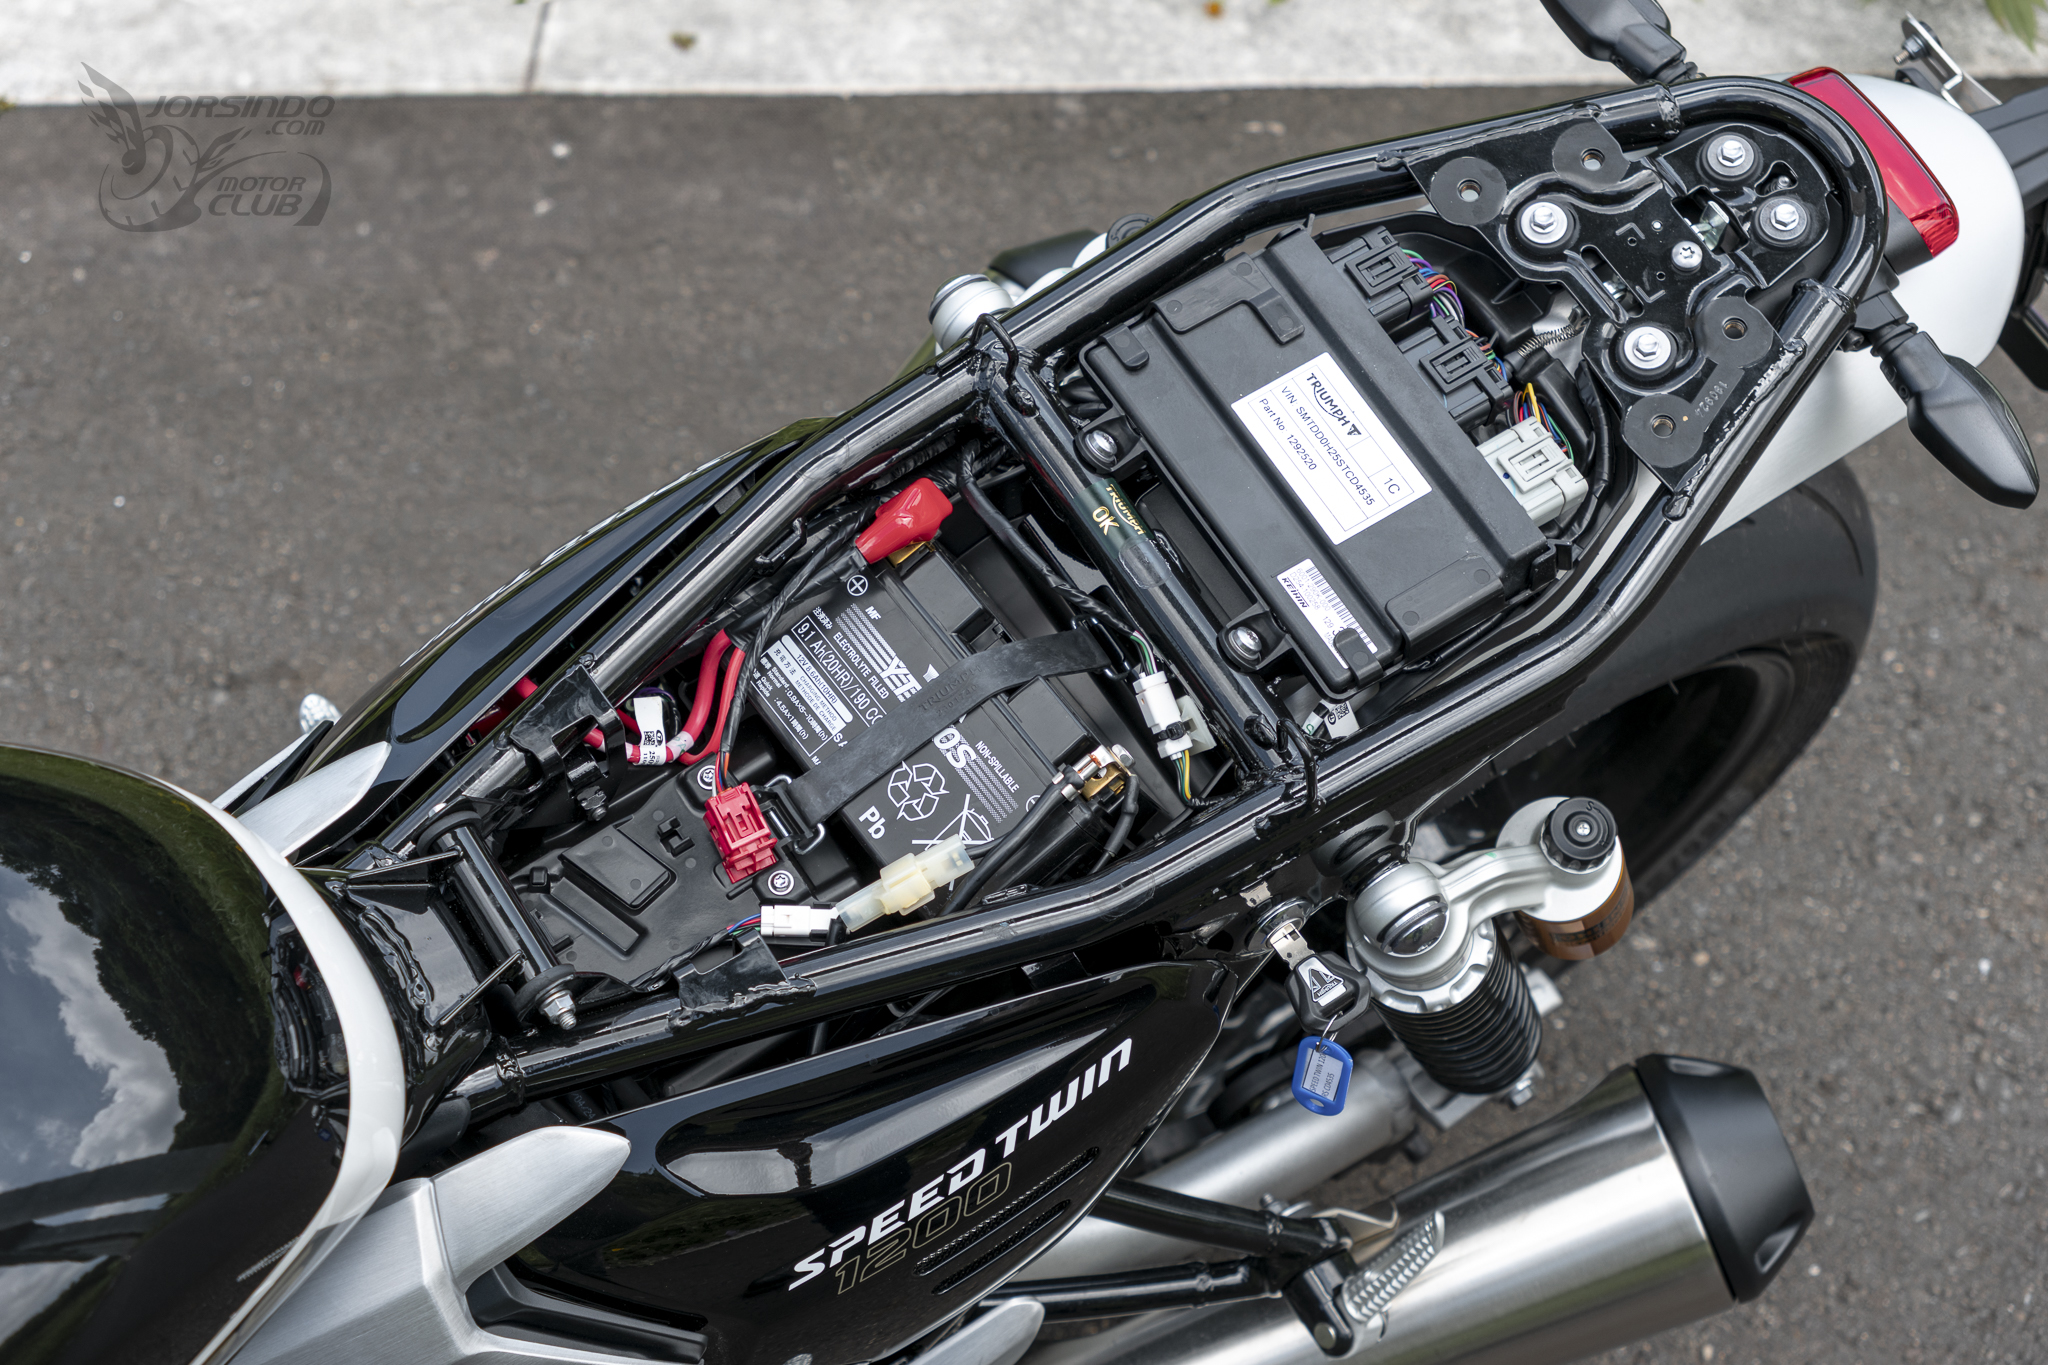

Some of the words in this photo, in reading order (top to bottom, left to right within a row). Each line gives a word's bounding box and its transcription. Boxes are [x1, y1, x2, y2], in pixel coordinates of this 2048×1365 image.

[1280, 386, 1299, 407] VIN:
[1305, 373, 1350, 427] TRIUMPH
[1259, 397, 1277, 418] Part
[1273, 416, 1289, 434] No:
[1286, 433, 1317, 472] 1292520
[1382, 477, 1401, 496] 1C
[1092, 505, 1120, 536] OK
[1105, 483, 1147, 535] TRIUMPH
[1281, 575, 1310, 610] KEIHIN
[865, 605, 881, 622] MF
[796, 653, 808, 667] 12V
[796, 622, 817, 642] 9.1
[809, 637, 872, 712] Ah(20HR)/190
[833, 632, 871, 677] ELECTROLYTE
[867, 675, 889, 700] FILLED
[755, 679, 771, 698] Rapide
[760, 676, 774, 692] Quick
[766, 671, 783, 689] Normal
[770, 667, 790, 689] Standard
[799, 675, 822, 702] CHARGING
[819, 700, 837, 722] METHOD
[812, 702, 821, 711] DE
[818, 710, 837, 732] CHARGE
[975, 740, 1020, 793] NON-SPILLABLE
[858, 805, 891, 841] Pb
[1309, 1076, 1320, 1092] SPEED
[1314, 1063, 1323, 1077] TWIN
[788, 1147, 986, 1292] SPEED
[995, 1037, 1133, 1158] TWIN
[835, 1161, 1013, 1295] 1200
